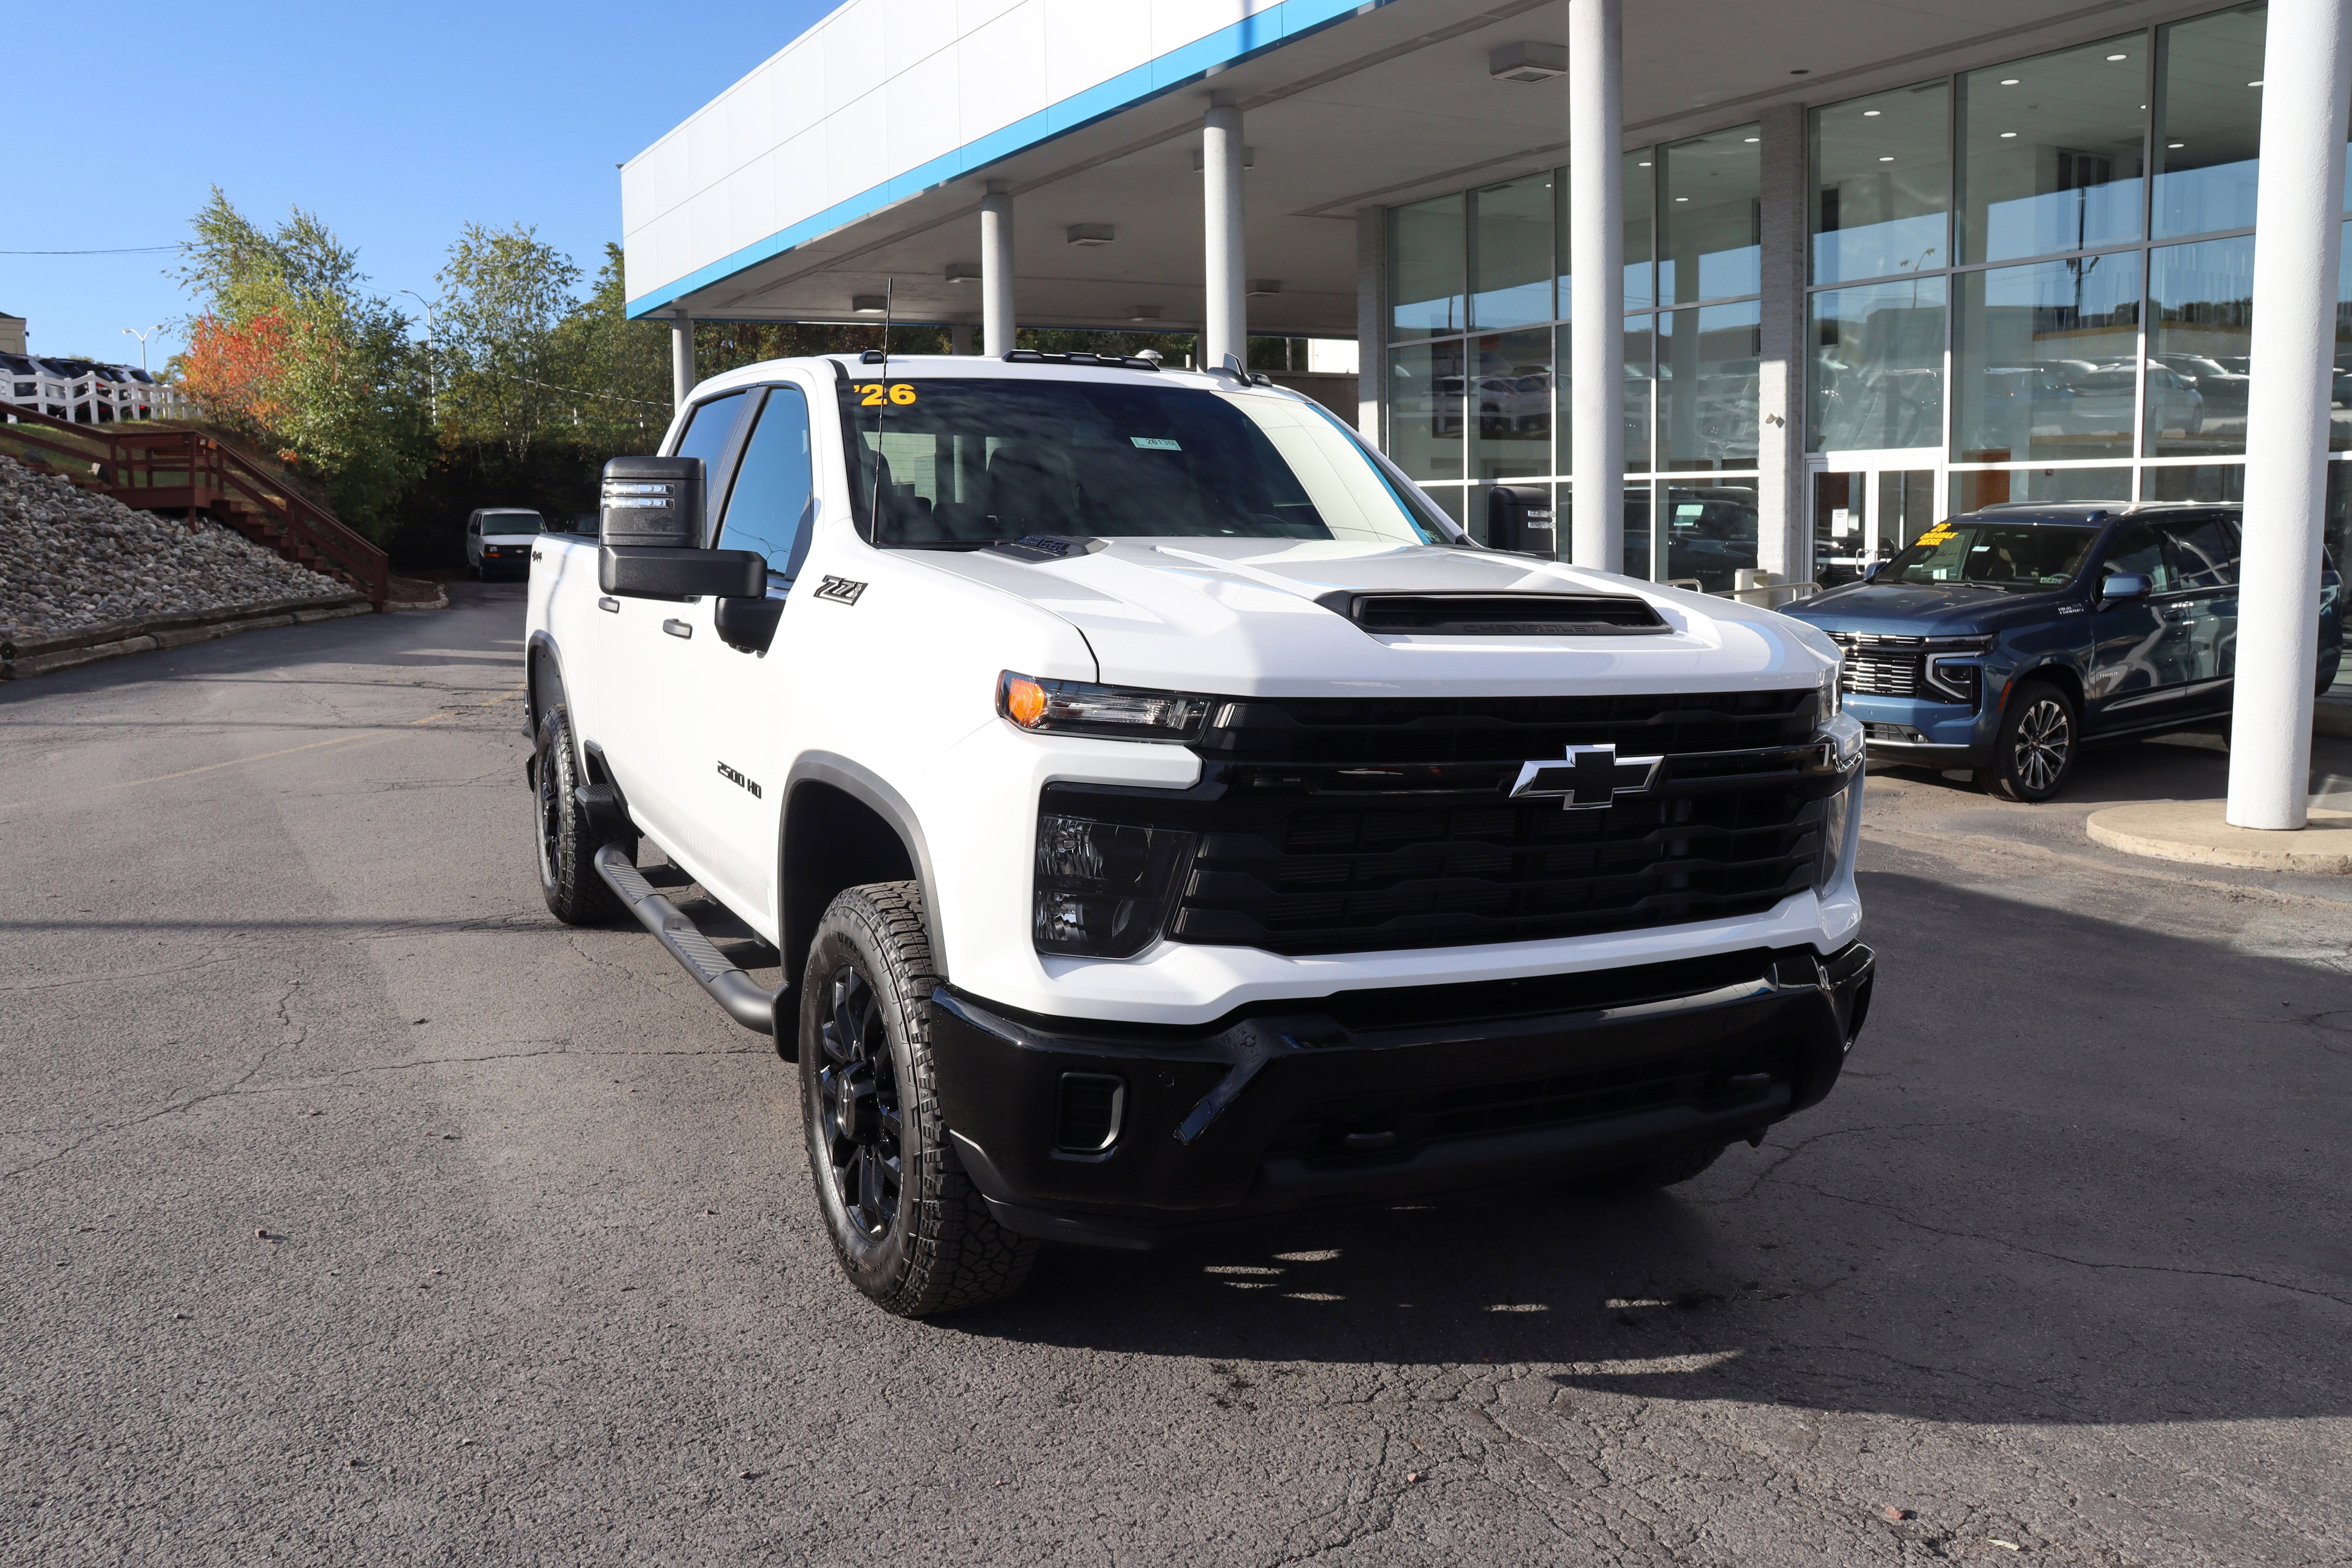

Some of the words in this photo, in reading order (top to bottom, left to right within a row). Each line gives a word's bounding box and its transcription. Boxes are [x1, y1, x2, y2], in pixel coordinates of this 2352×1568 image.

[813, 574, 869, 606] Z71
[717, 760, 745, 788] 2500
[747, 778, 762, 800] HD
